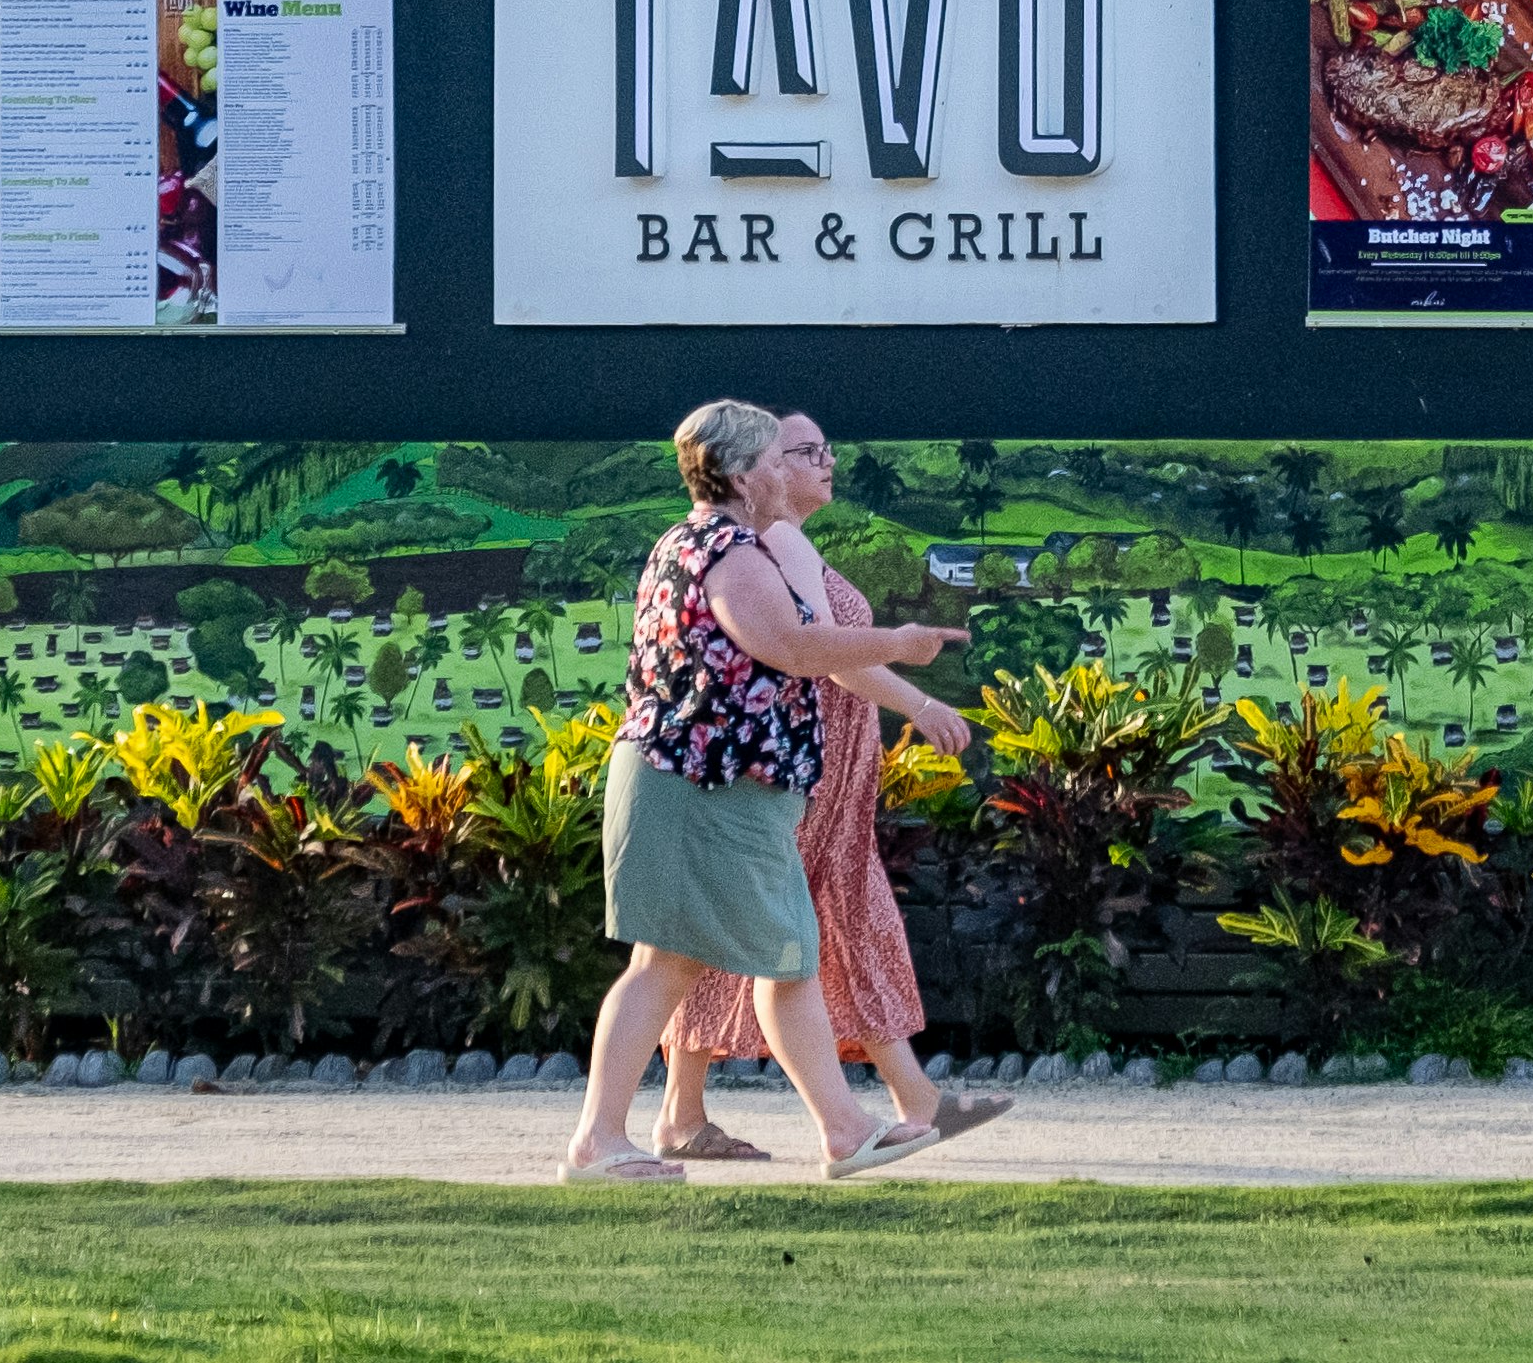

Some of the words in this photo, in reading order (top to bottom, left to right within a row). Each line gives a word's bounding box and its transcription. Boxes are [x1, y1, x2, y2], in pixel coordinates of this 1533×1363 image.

[223, 0, 278, 17] Wine
[281, 0, 342, 17] Menu
[54, 95, 67, 104] To
[54, 177, 67, 185] To
[637, 213, 780, 262] BAR
[815, 212, 856, 262] &
[888, 212, 1103, 262] GRILL
[1368, 228, 1438, 243] Butcher
[1441, 228, 1490, 247] Night
